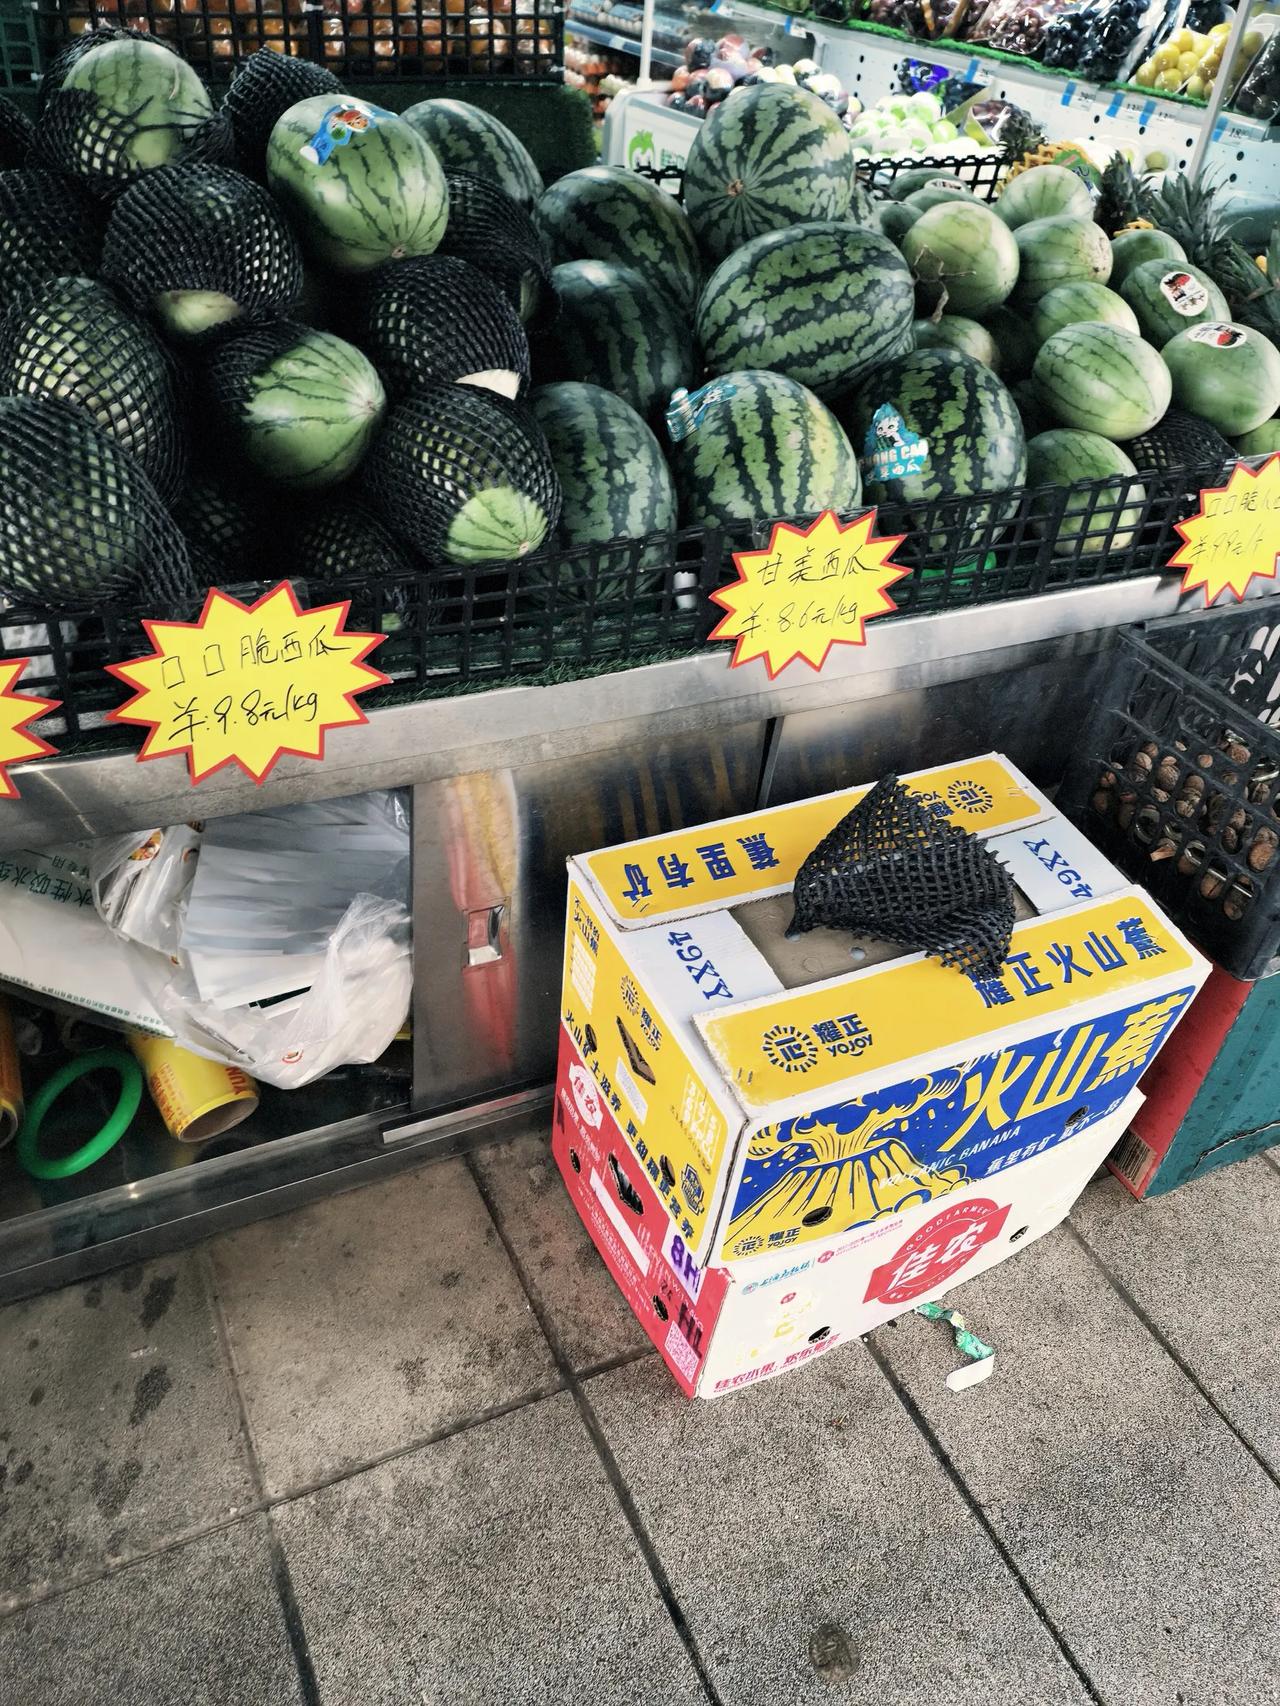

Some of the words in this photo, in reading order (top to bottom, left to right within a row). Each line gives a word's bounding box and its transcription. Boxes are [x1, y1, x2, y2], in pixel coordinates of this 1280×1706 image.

[757, 545, 881, 586] 甘美西瓜
[622, 833, 781, 902] 蕉里有矿
[825, 1033, 873, 1057] YOJOY
[937, 991, 1190, 1153] 火山蕉
[959, 1125, 1022, 1161] BANANA
[766, 1236, 799, 1249] YOJOY
[887, 1220, 988, 1292] 佳农
